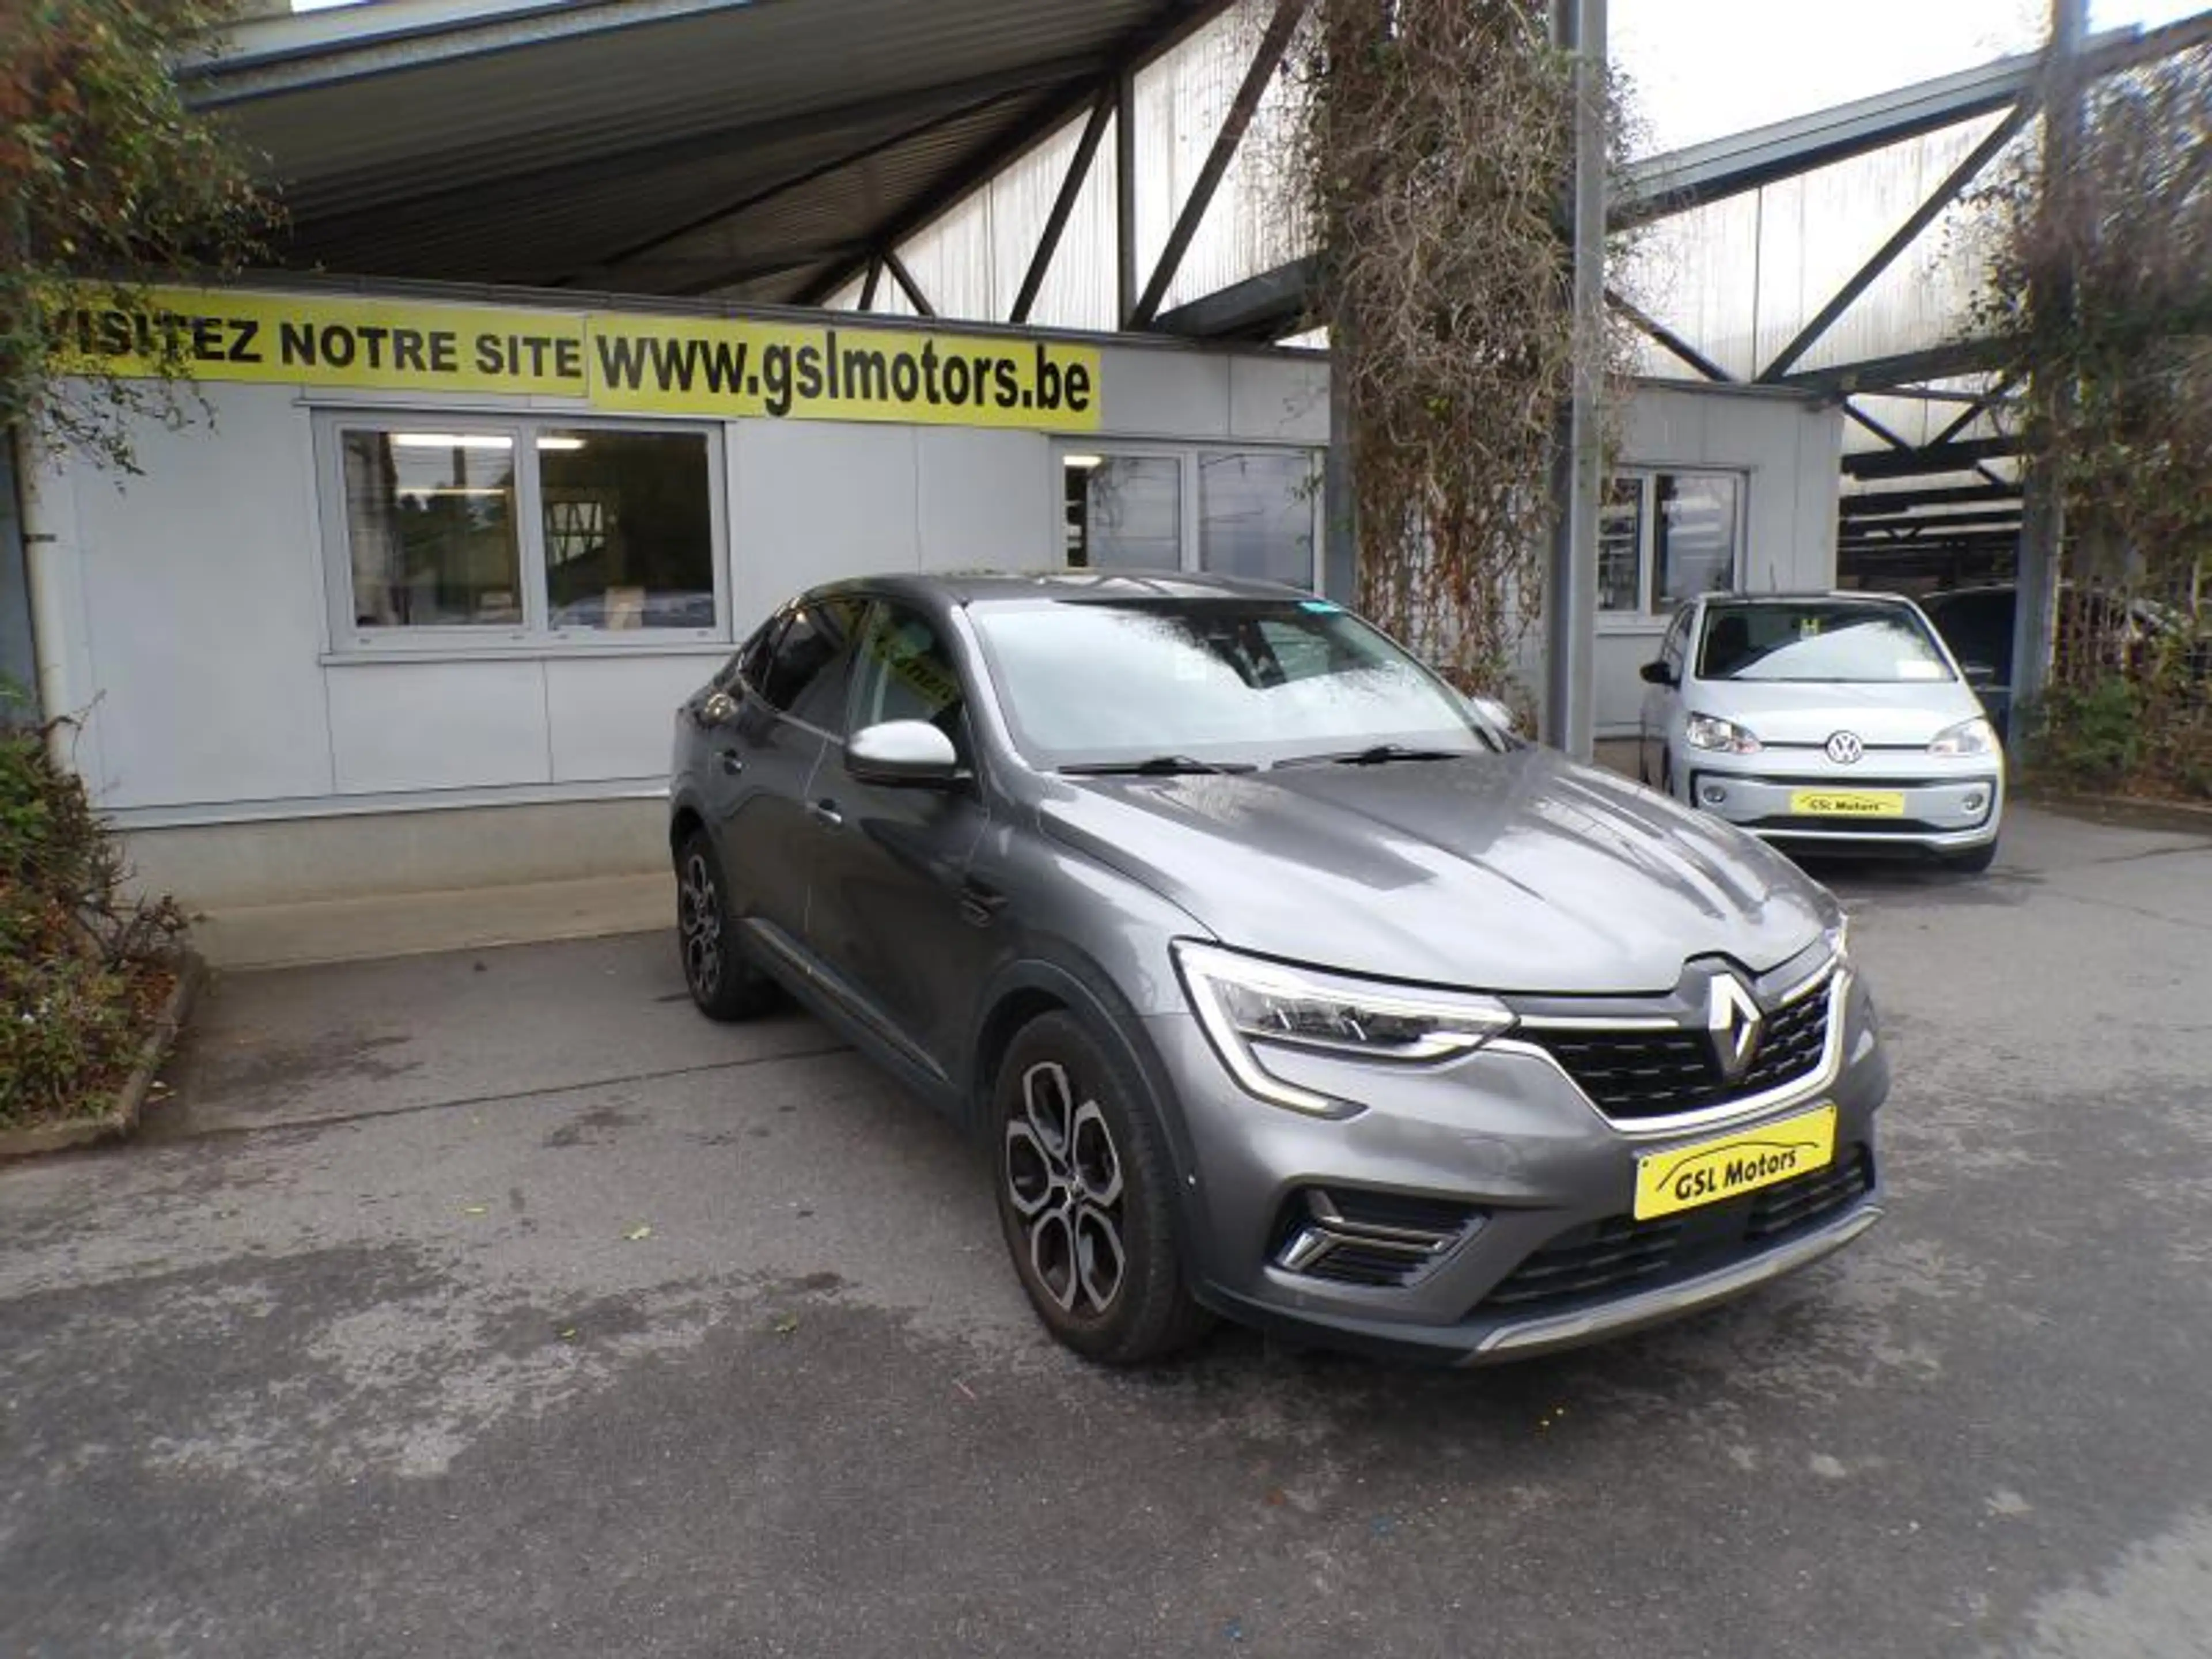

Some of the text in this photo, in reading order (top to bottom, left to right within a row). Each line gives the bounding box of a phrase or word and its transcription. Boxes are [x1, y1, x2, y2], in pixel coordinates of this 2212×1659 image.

[281, 323, 458, 372] NOTRE
[475, 334, 582, 378] SITE
[596, 331, 1090, 416] www.gslmotors.be
[1675, 1150, 1796, 1200] GSL Motors
